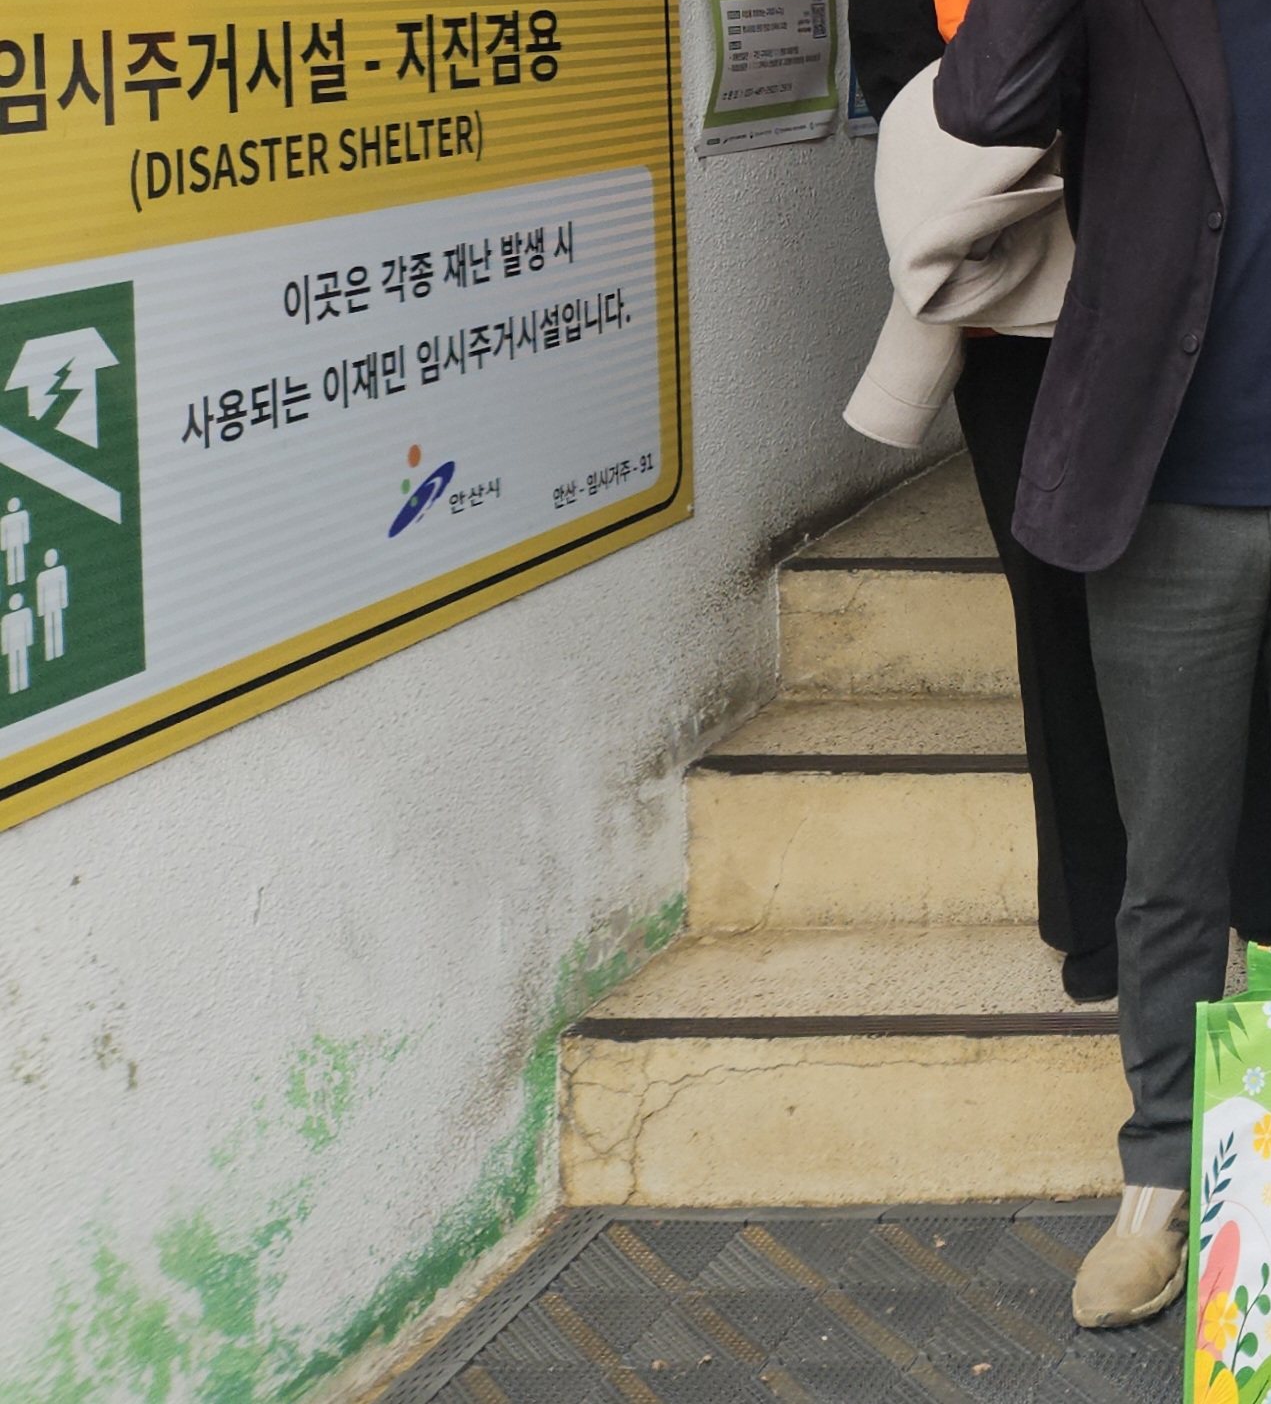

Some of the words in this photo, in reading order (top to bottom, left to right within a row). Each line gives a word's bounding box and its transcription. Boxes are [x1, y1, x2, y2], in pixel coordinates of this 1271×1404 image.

[0, 16, 348, 135] 임시주거시설
[395, 9, 564, 94] 지진겸용
[130, 131, 328, 212] (DISASTER
[337, 109, 485, 173] SHELTER)
[282, 263, 371, 326] 이곳은
[380, 250, 433, 303] 각종
[443, 237, 493, 289] 재난
[500, 225, 547, 278] 발생
[554, 220, 575, 265] 시
[181, 376, 311, 449] 사용되는
[322, 343, 406, 410] 이재민
[416, 287, 634, 383] 임시주거시설입니다.
[449, 477, 501, 515] 안산시
